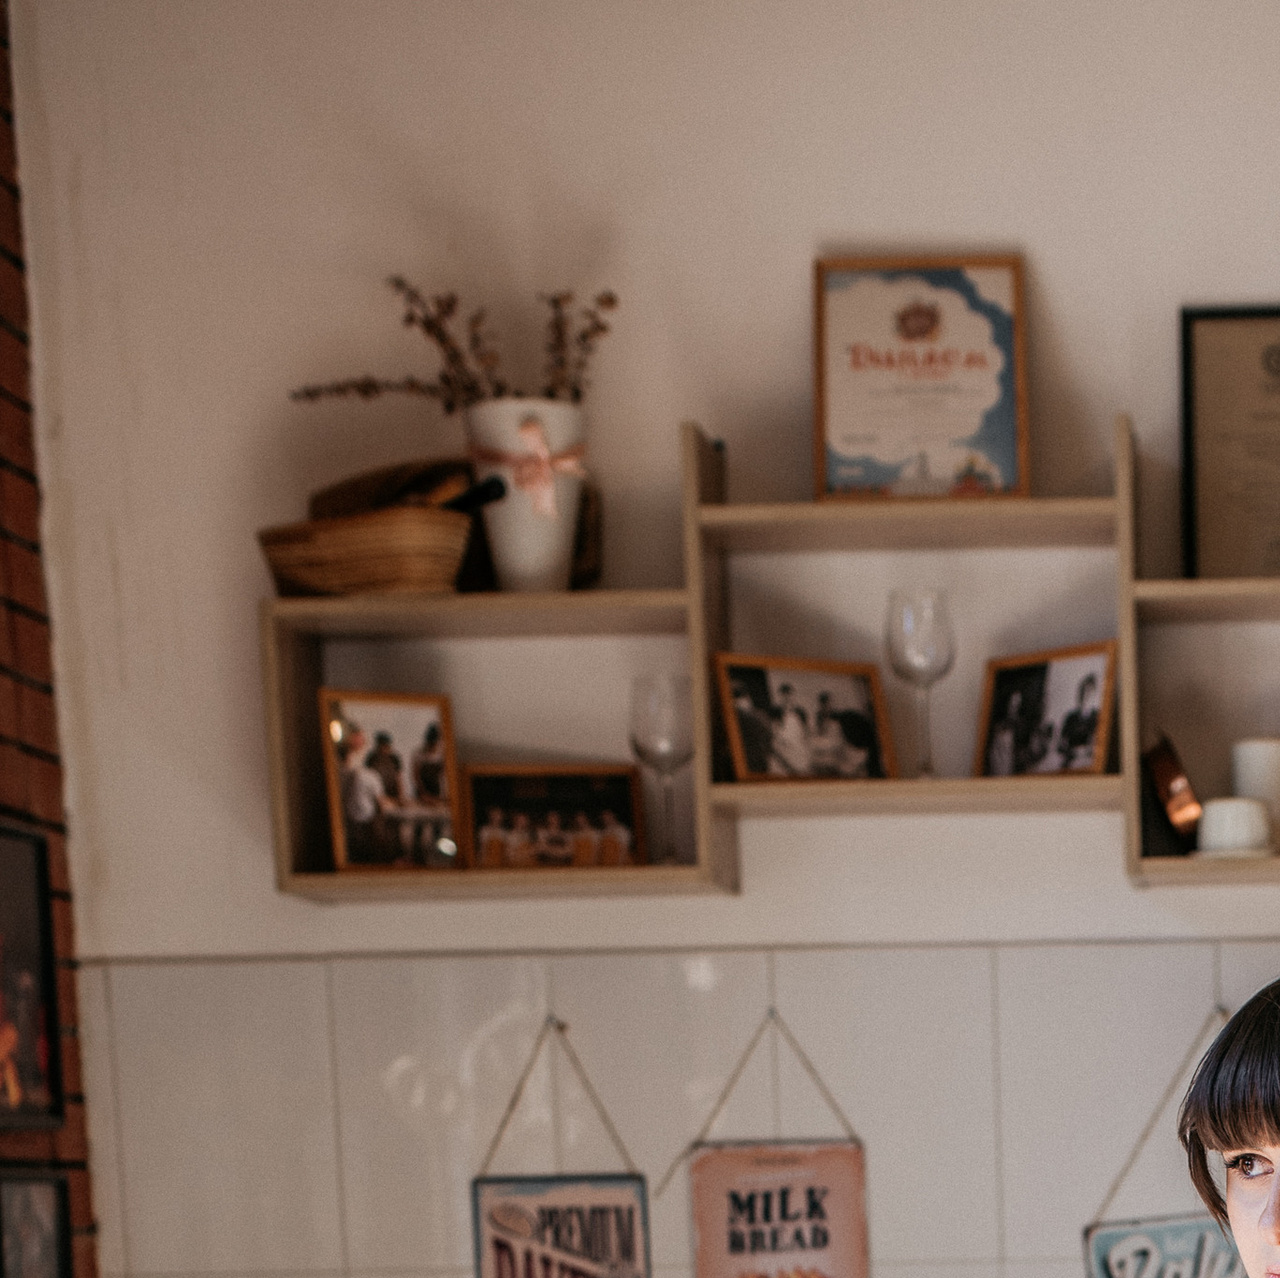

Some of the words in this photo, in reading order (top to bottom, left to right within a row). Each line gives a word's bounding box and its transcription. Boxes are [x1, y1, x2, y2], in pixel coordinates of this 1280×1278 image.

[728, 1186, 828, 1224] MILK
[535, 1204, 635, 1265] PREMIUM
[728, 1225, 829, 1254] BREAD
